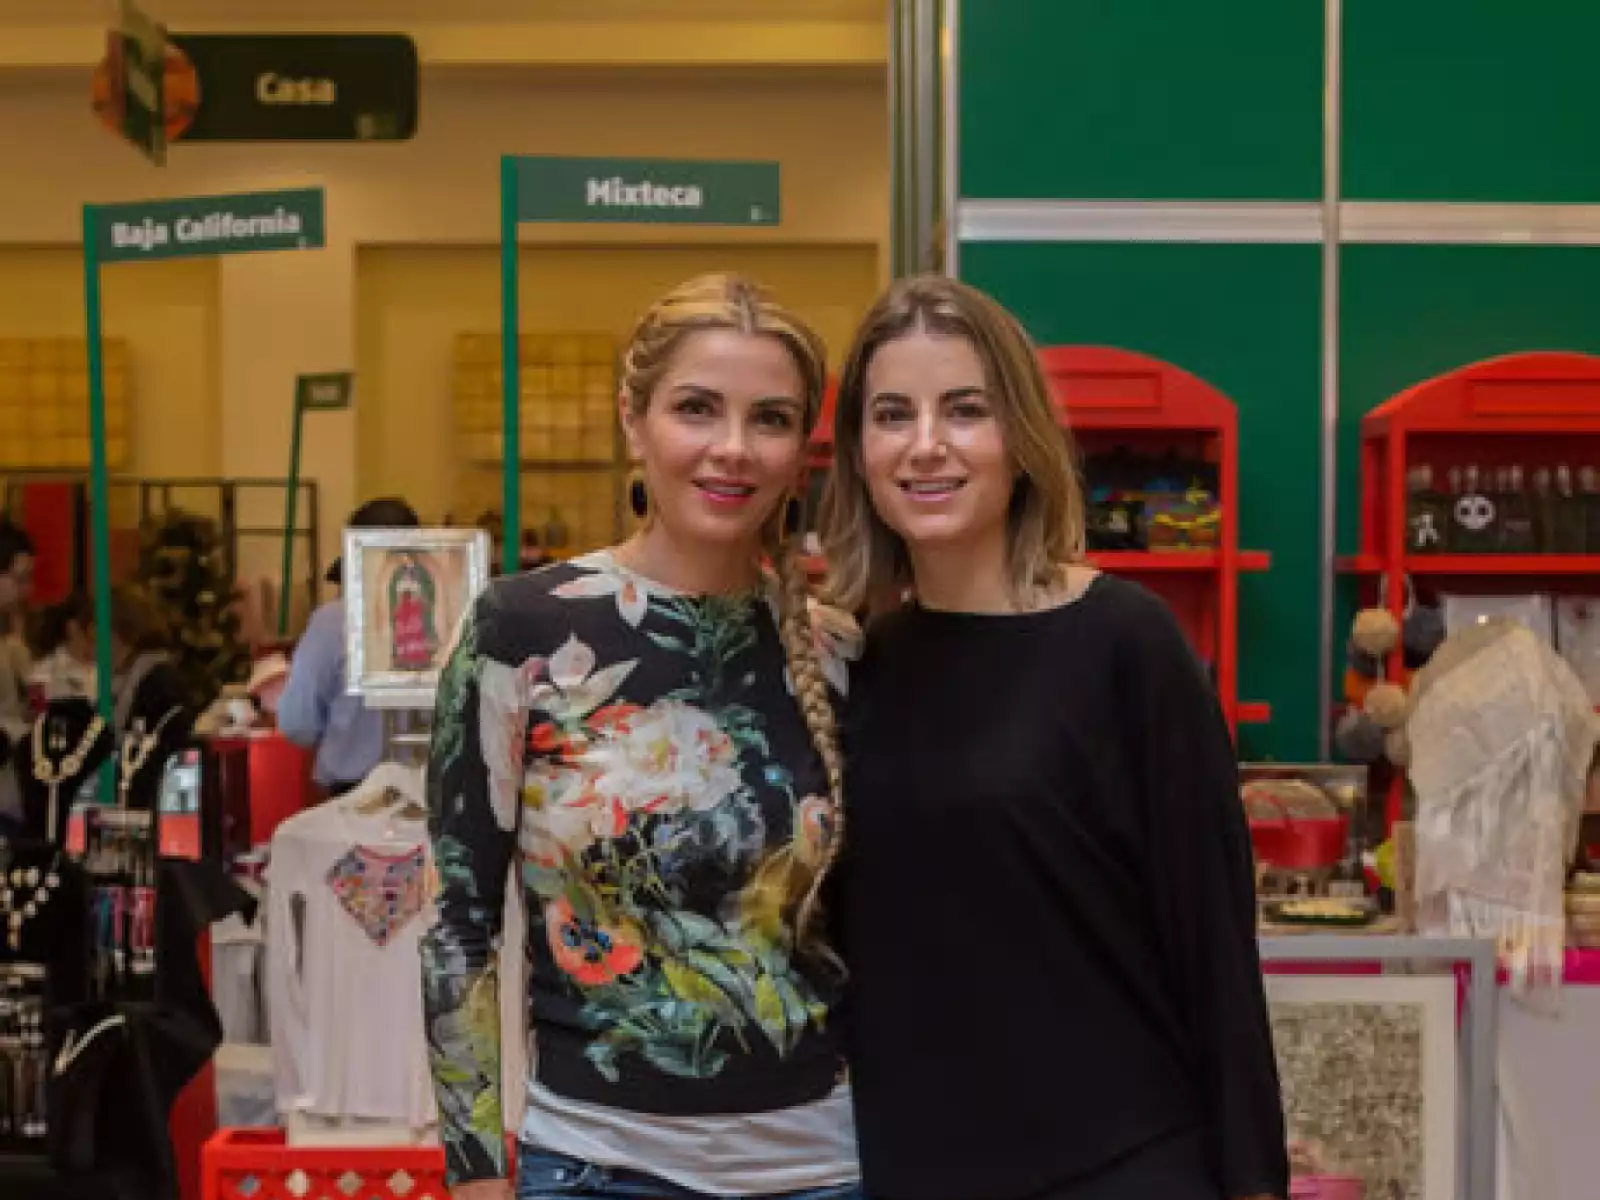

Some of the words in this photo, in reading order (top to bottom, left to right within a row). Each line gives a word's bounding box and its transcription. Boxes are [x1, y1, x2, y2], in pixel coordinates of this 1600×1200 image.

[256, 72, 336, 105] Casa
[585, 177, 703, 208] Mixteca
[111, 217, 169, 251] Baja
[174, 206, 302, 243] California
